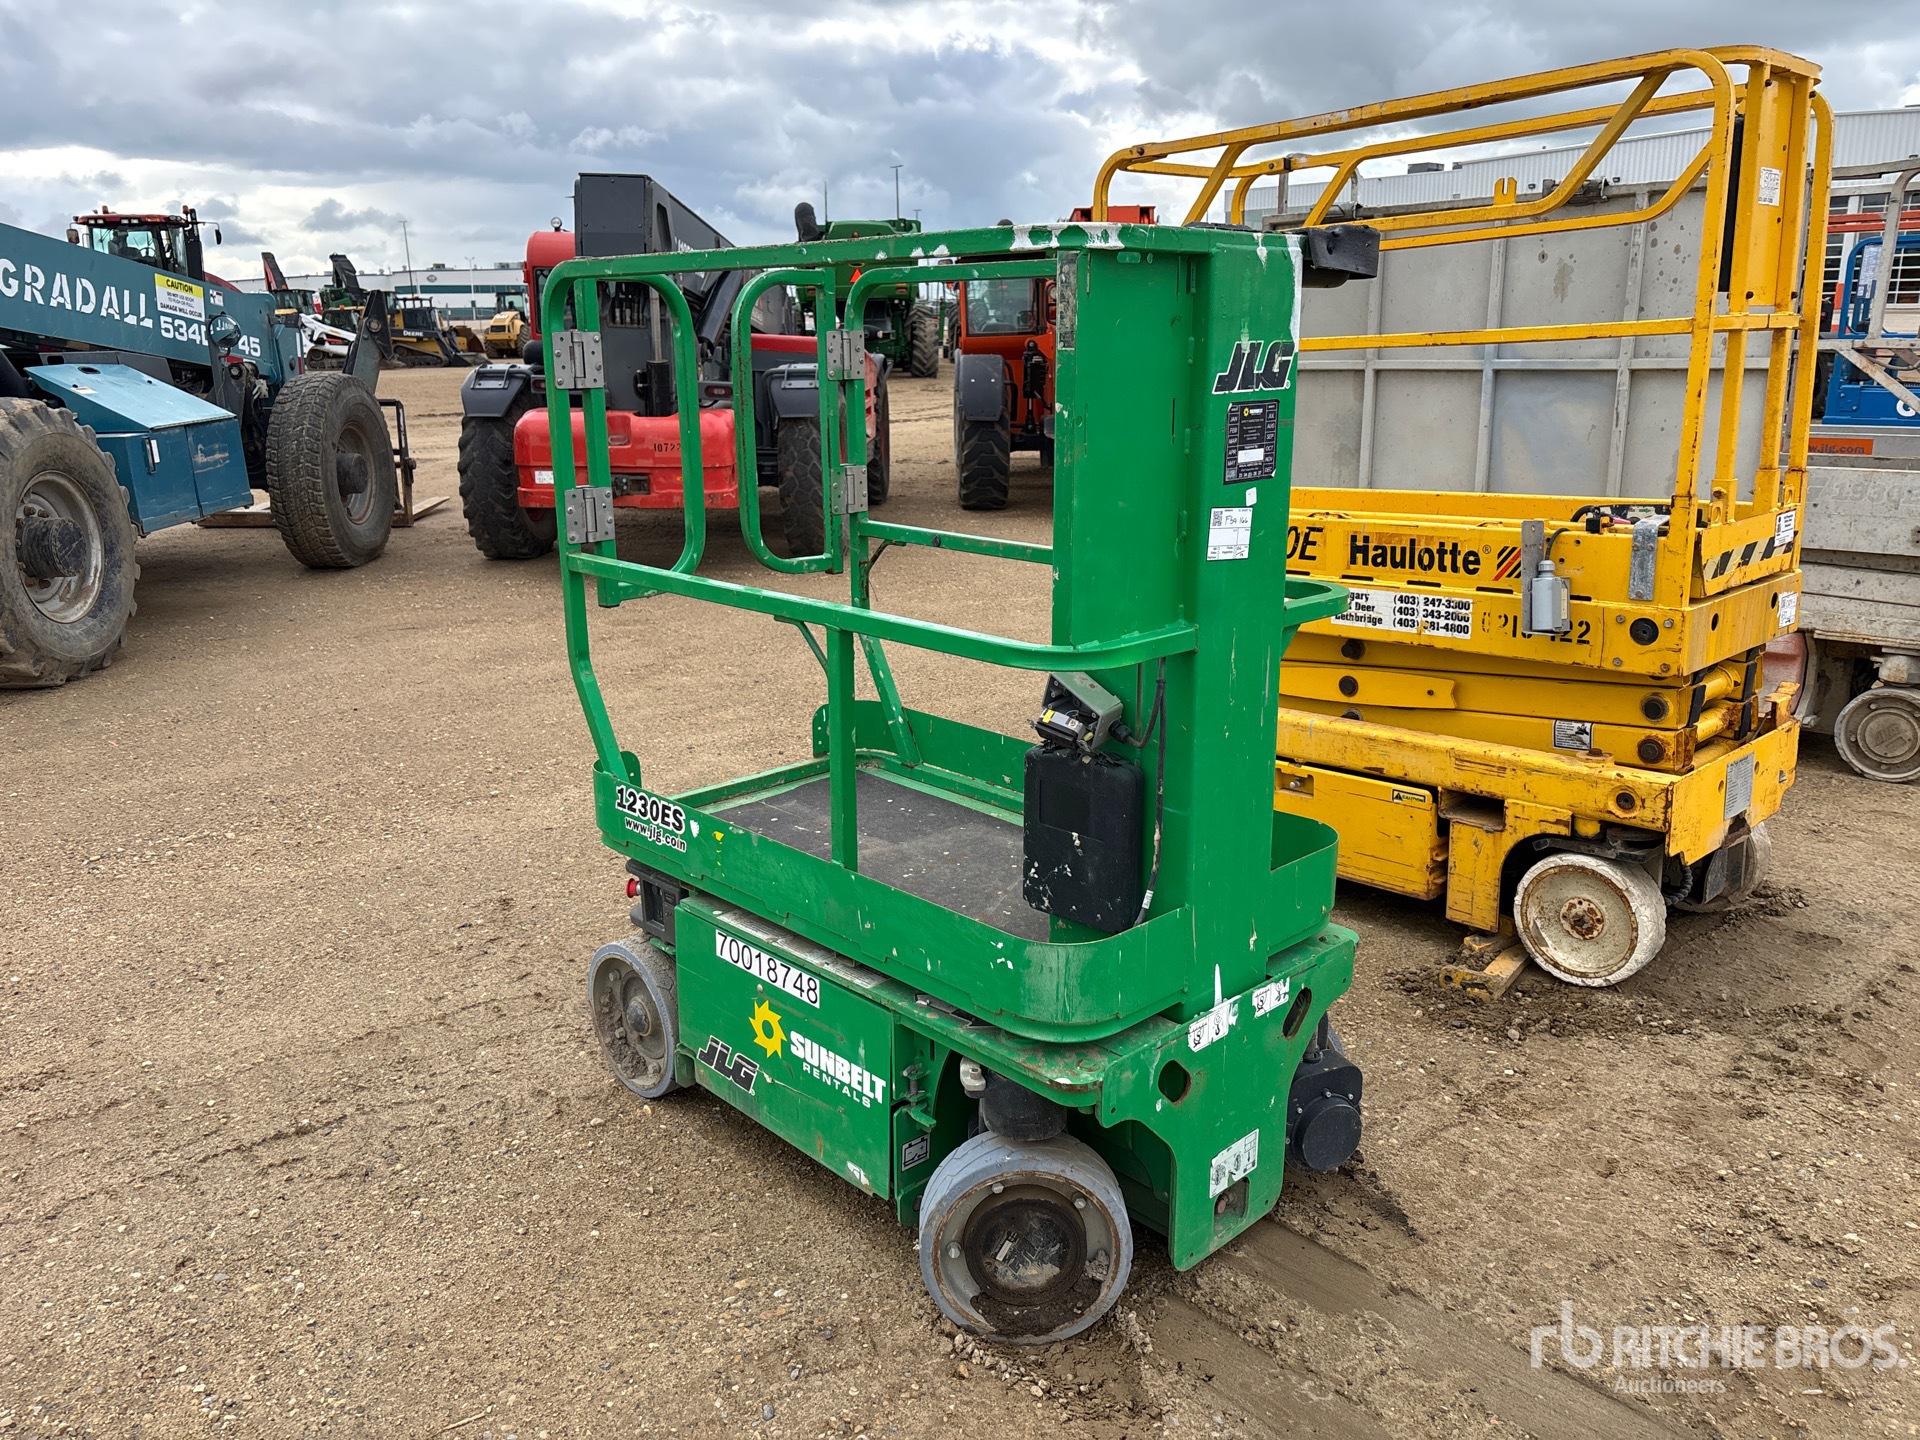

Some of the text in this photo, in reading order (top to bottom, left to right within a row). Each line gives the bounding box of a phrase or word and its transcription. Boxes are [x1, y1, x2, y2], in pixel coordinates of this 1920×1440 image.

[0, 258, 153, 328] GRADALL
[160, 302, 202, 318] DAMAGE WILL OCCUR
[166, 279, 194, 294] CAUTION
[1212, 341, 1296, 394] JLG
[1350, 534, 1481, 575] Haulotte
[1350, 591, 1370, 604] gary
[1393, 594, 1420, 606] (403)
[1355, 602, 1375, 612] Deer
[1393, 606, 1419, 618] (403)
[1393, 617, 1420, 629] (403)
[616, 785, 686, 834] 1230ES
[717, 932, 819, 1005] 70018748
[697, 1034, 760, 1093] JLG
[789, 1030, 887, 1104] SUNBELT
[803, 1061, 871, 1109] RENTALS
